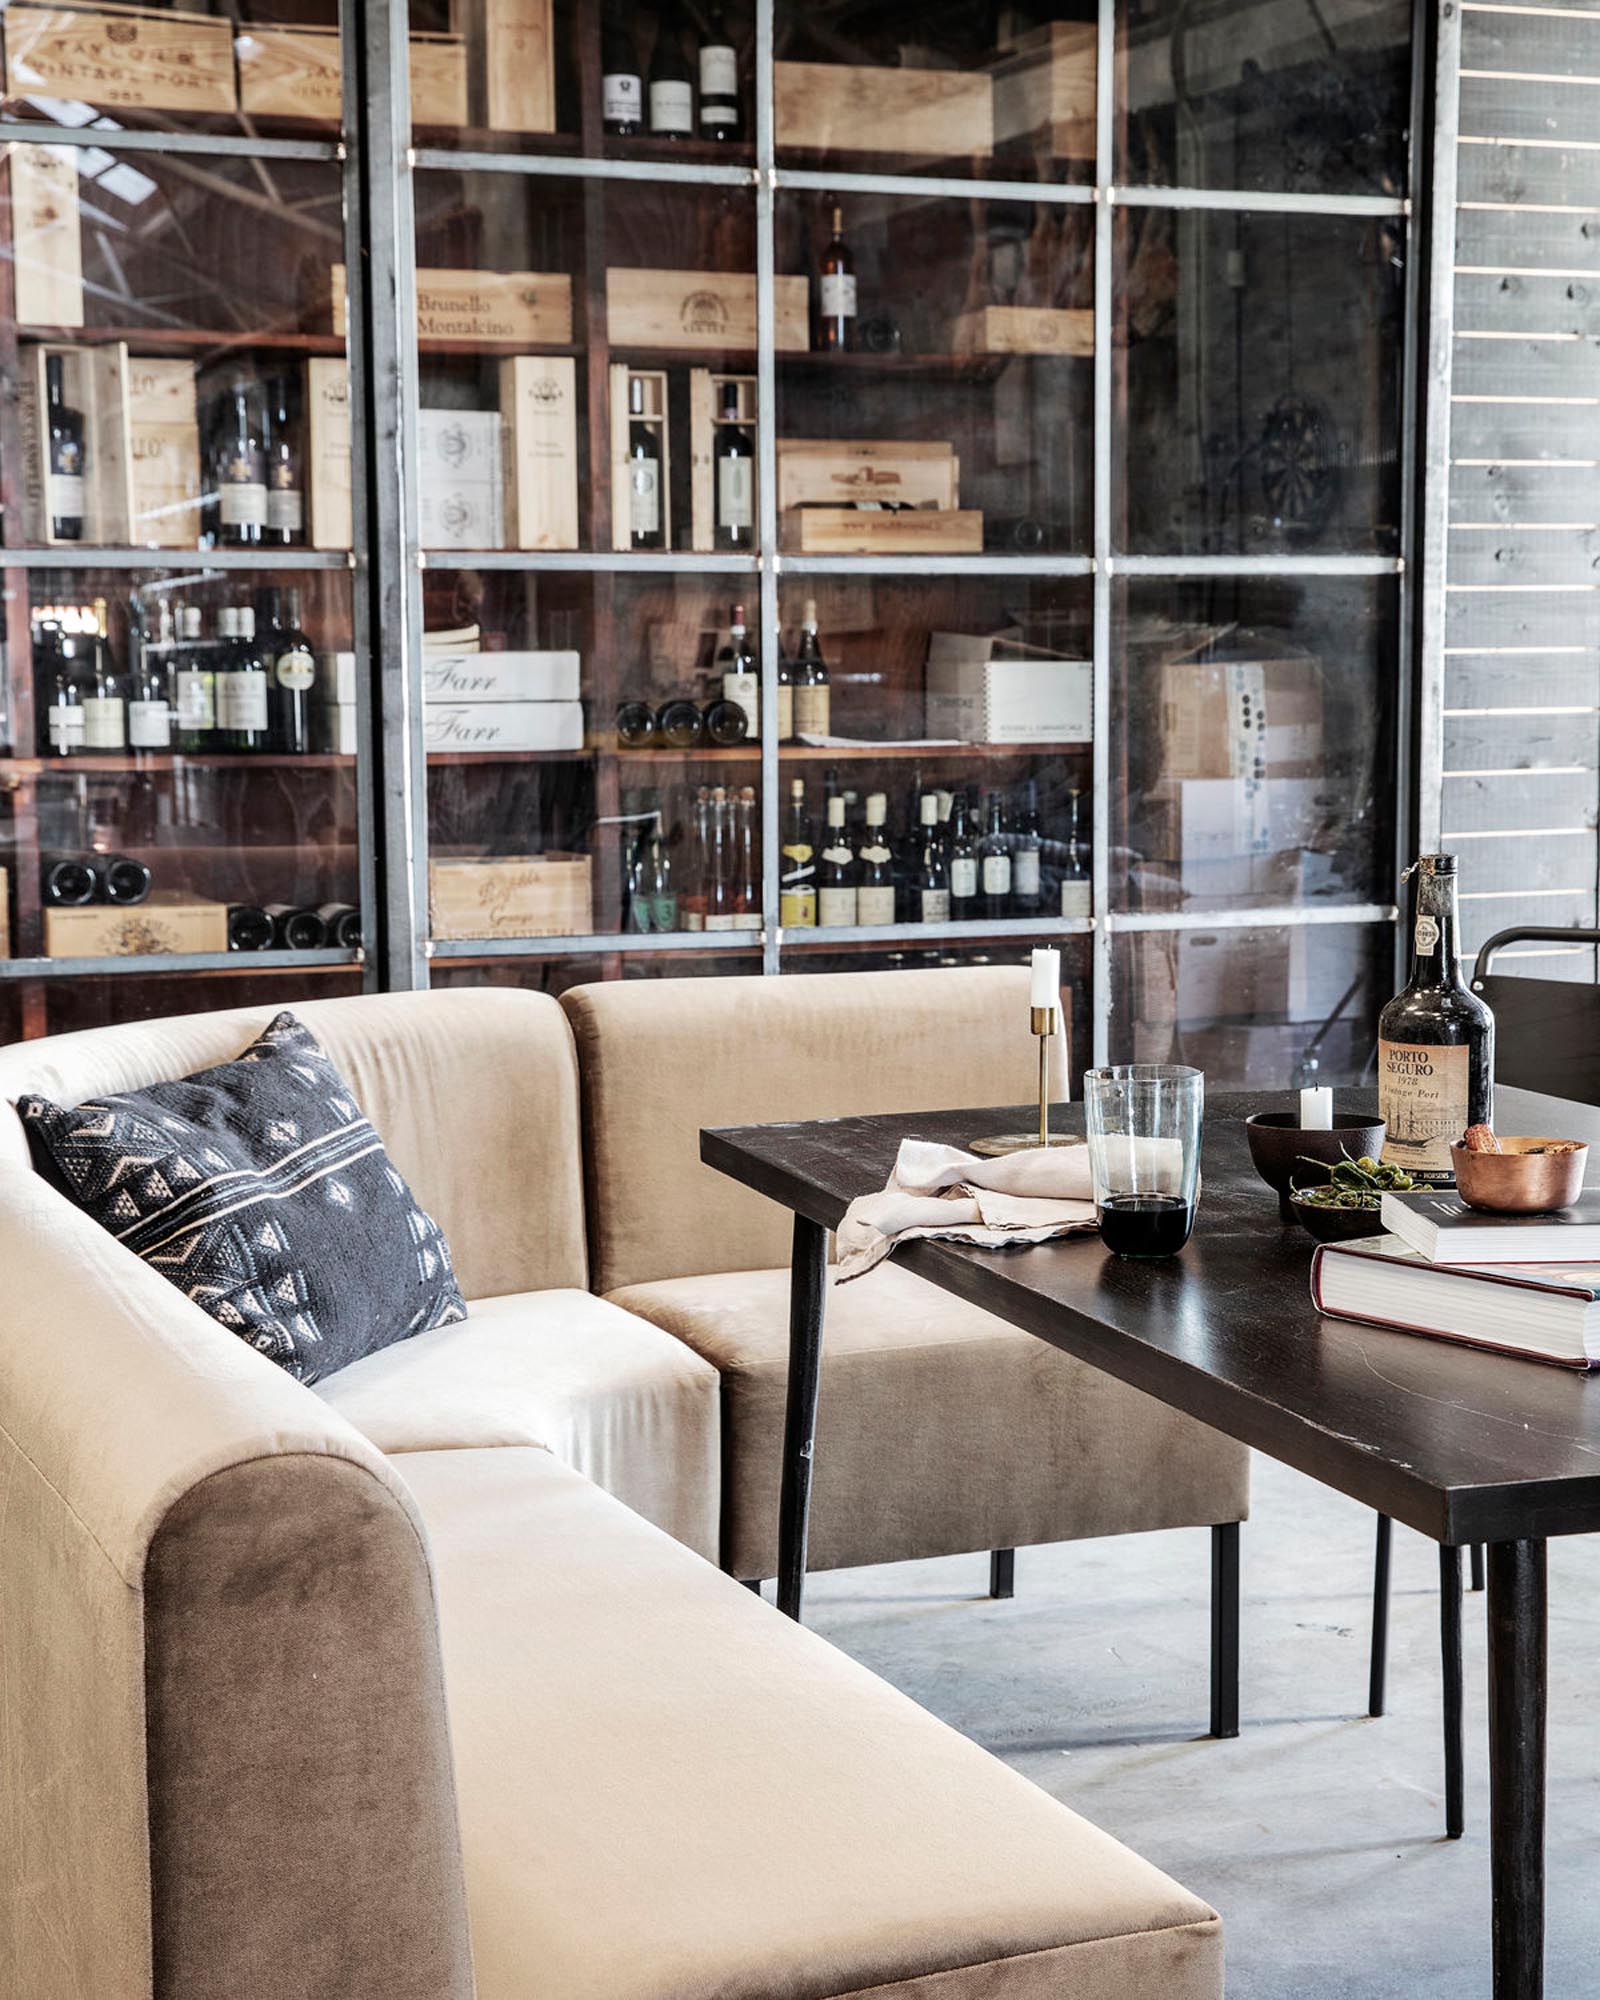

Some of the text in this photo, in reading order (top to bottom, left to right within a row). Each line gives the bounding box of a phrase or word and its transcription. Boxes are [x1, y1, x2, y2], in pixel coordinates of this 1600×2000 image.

[418, 293, 491, 313] Brunello
[417, 317, 515, 336] Montalcino
[425, 658, 497, 691] Farr
[425, 709, 500, 742] Farr
[1389, 1049, 1429, 1063] PORTO
[1386, 1062, 1433, 1076] SEGURO
[1397, 1075, 1418, 1085] 1978
[1417, 1089, 1440, 1098] Port
